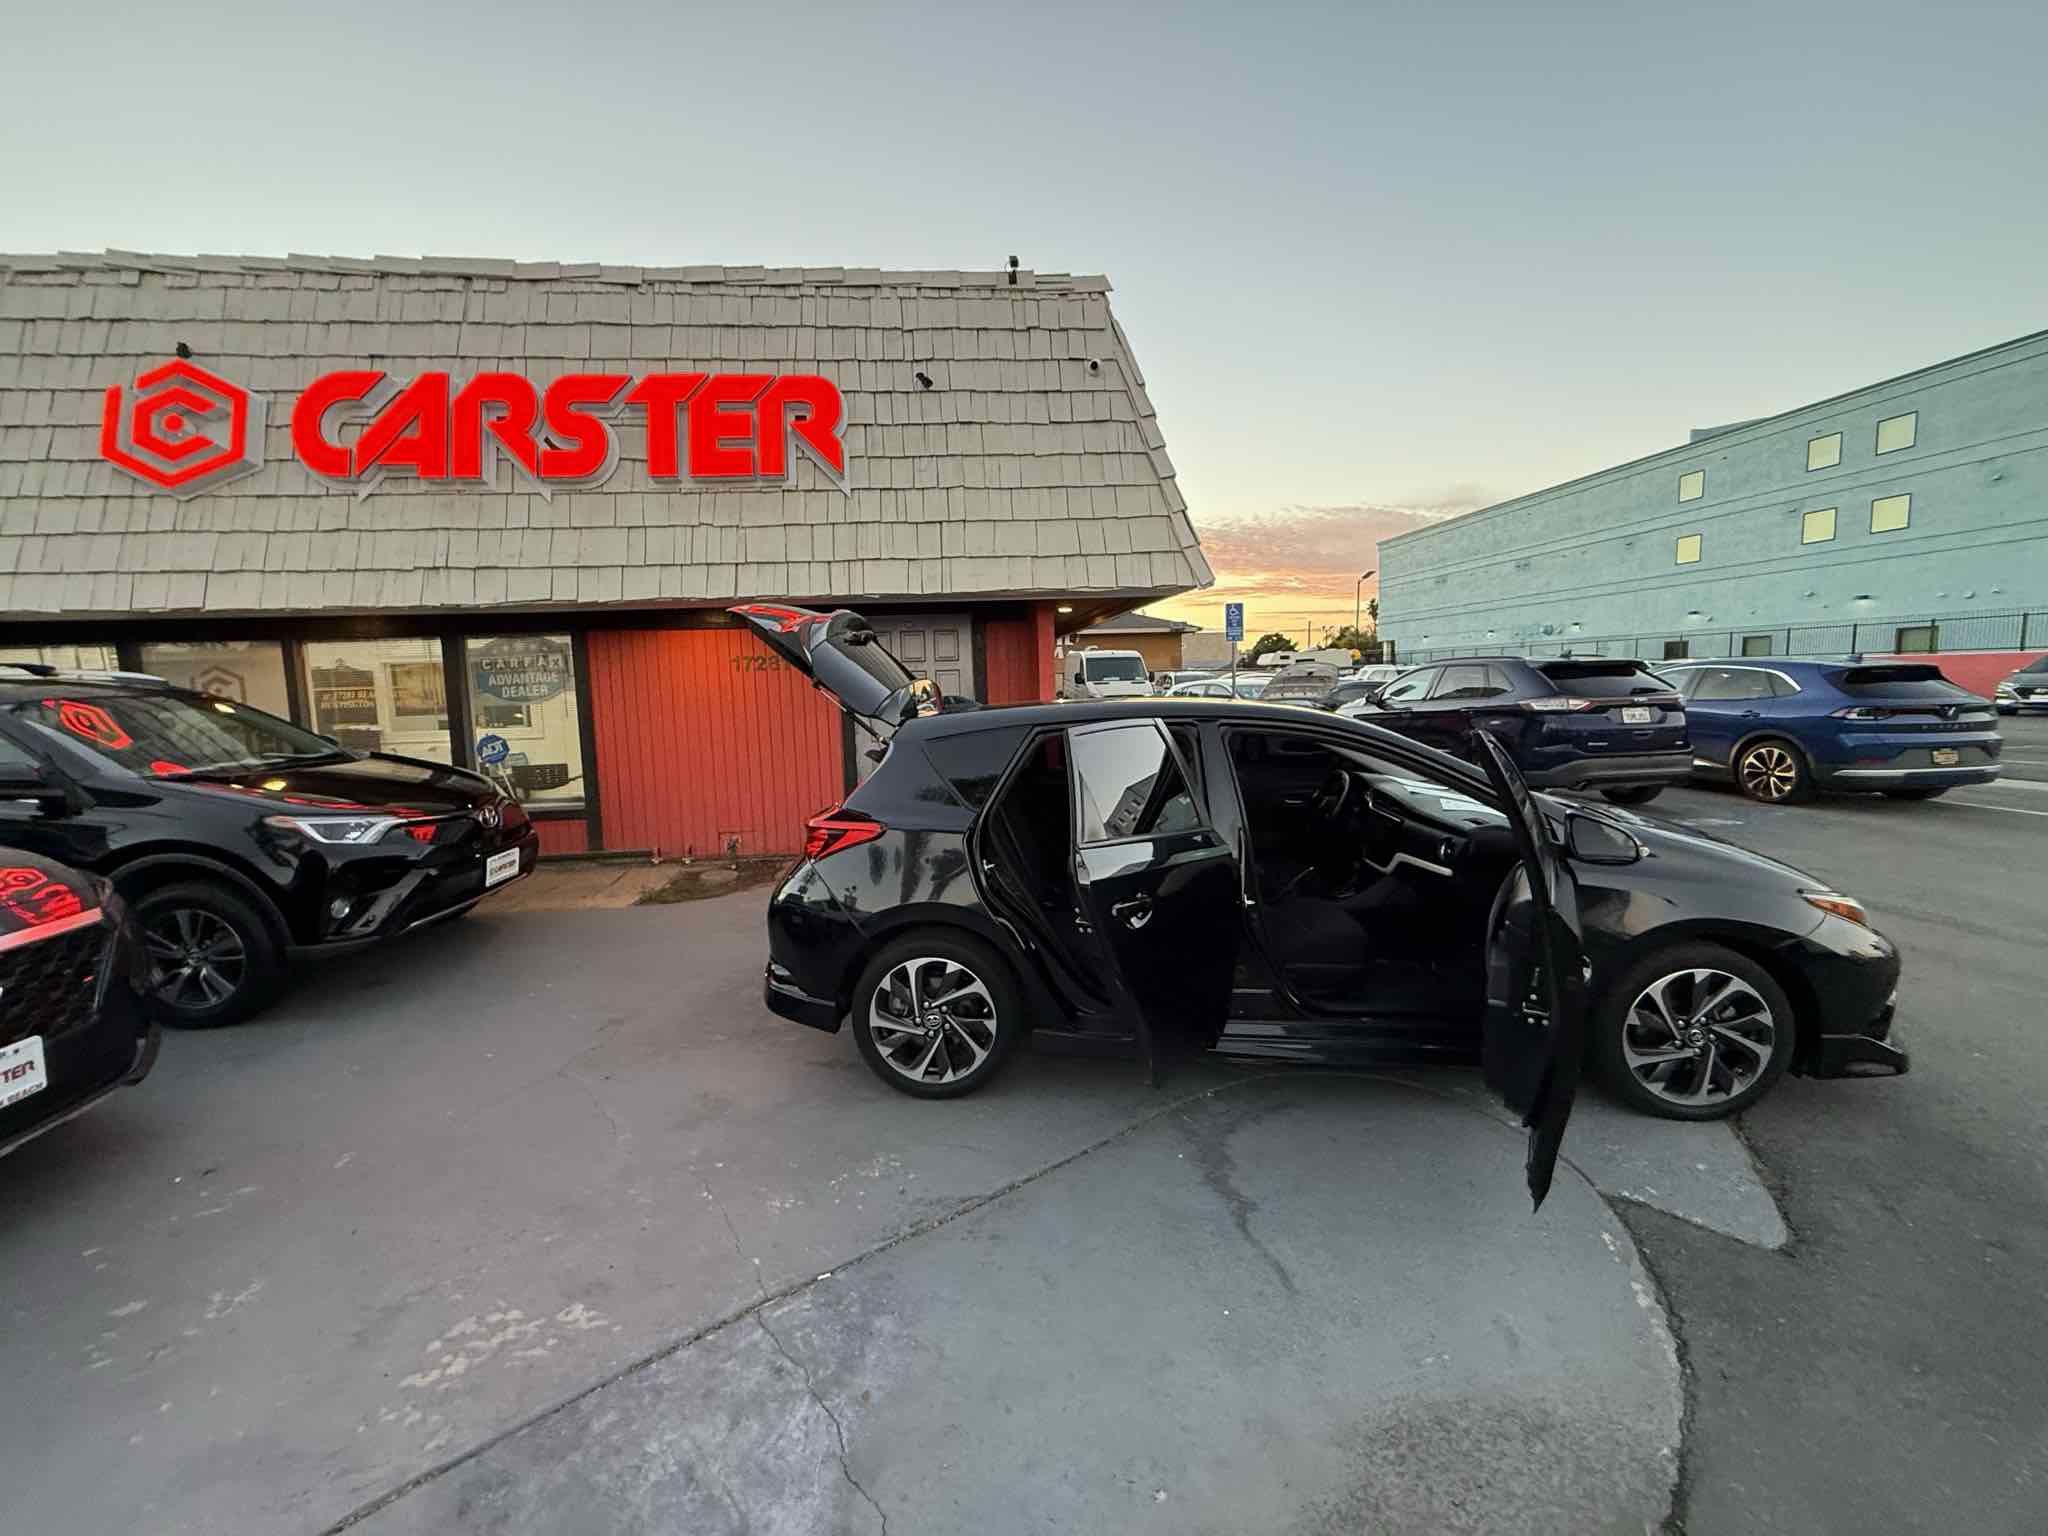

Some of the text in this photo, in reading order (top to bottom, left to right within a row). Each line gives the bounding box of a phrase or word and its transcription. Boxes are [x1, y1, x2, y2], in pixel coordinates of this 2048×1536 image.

[291, 370, 846, 480] CARSTER
[481, 654, 561, 670] CARFAX
[487, 670, 560, 687] ADVANTAGE
[501, 684, 549, 698] DEALER
[481, 740, 505, 758] ADT
